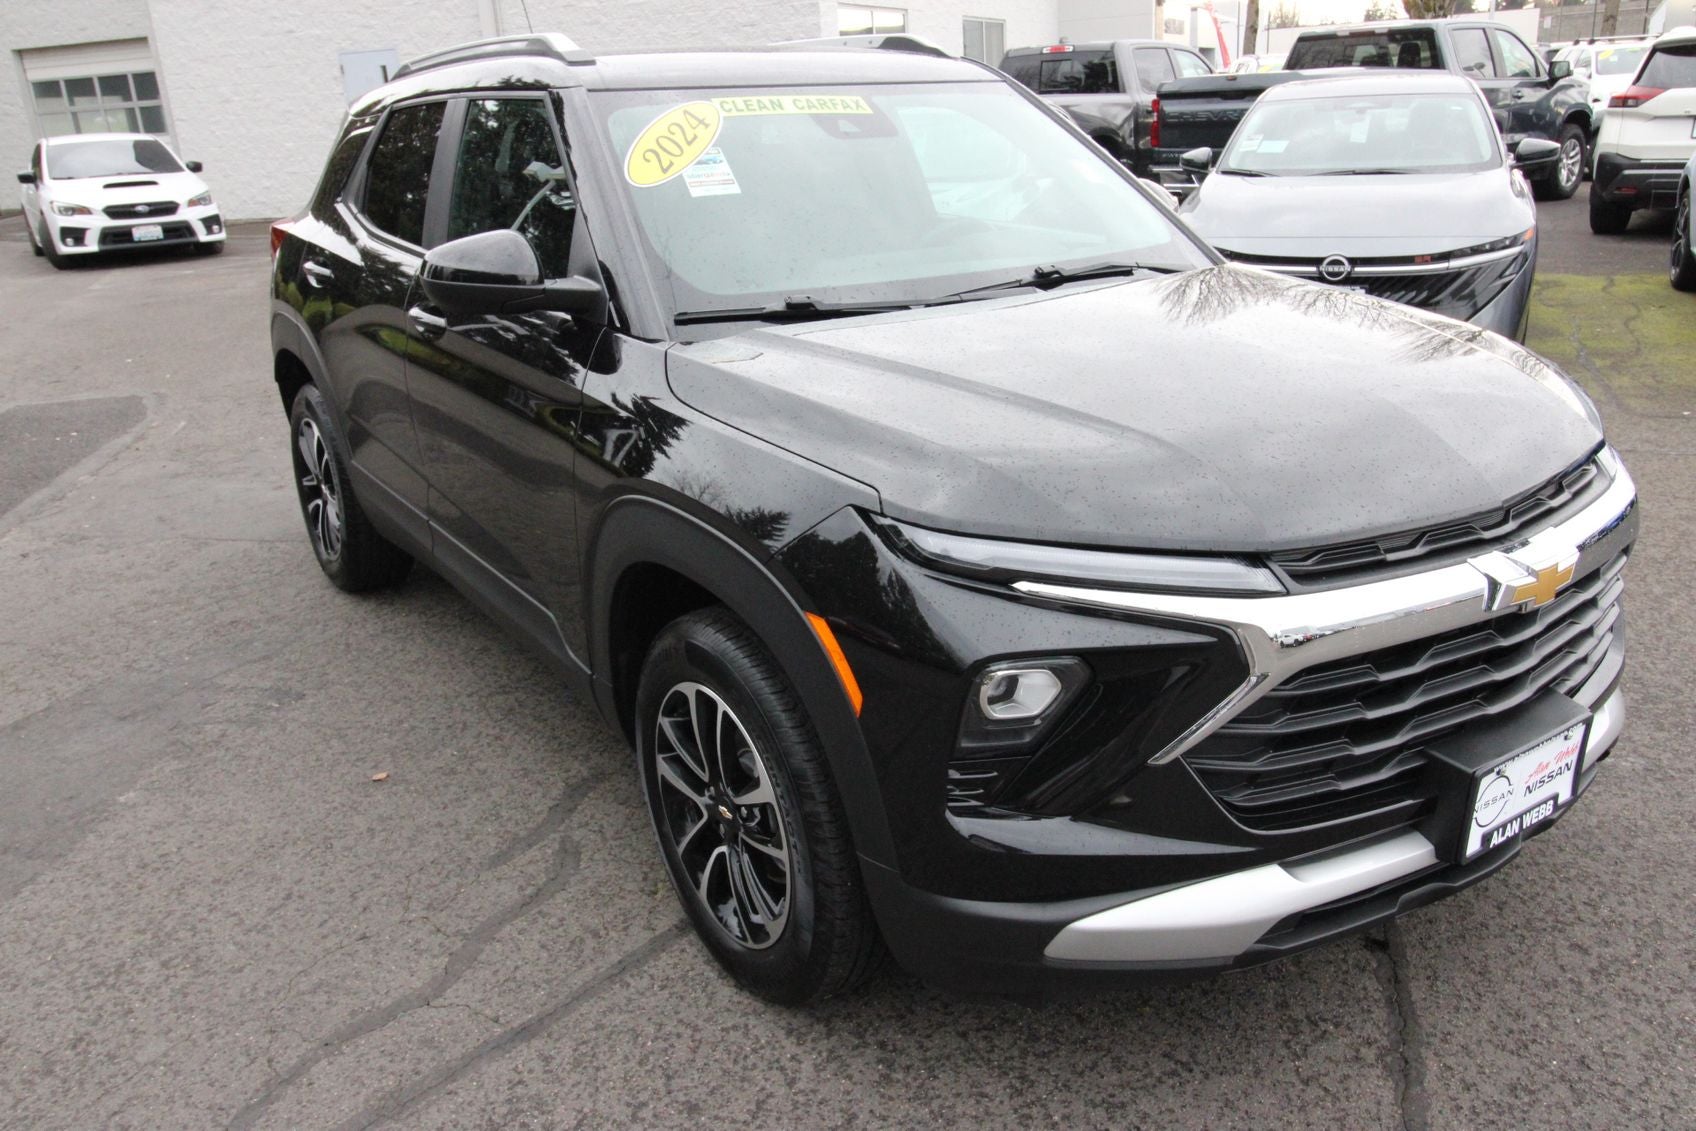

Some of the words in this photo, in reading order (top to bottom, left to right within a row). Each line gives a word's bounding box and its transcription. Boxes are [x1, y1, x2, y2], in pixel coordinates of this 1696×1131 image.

[719, 98, 784, 113] CLEAN
[792, 97, 867, 112] CARFAX
[1166, 109, 1247, 122] CHEVR
[642, 109, 711, 175] 2024
[1524, 760, 1573, 797] NISSAN
[1474, 788, 1514, 814] NISSAN
[1490, 818, 1521, 848] ALAN
[1522, 799, 1554, 829] WEBB
